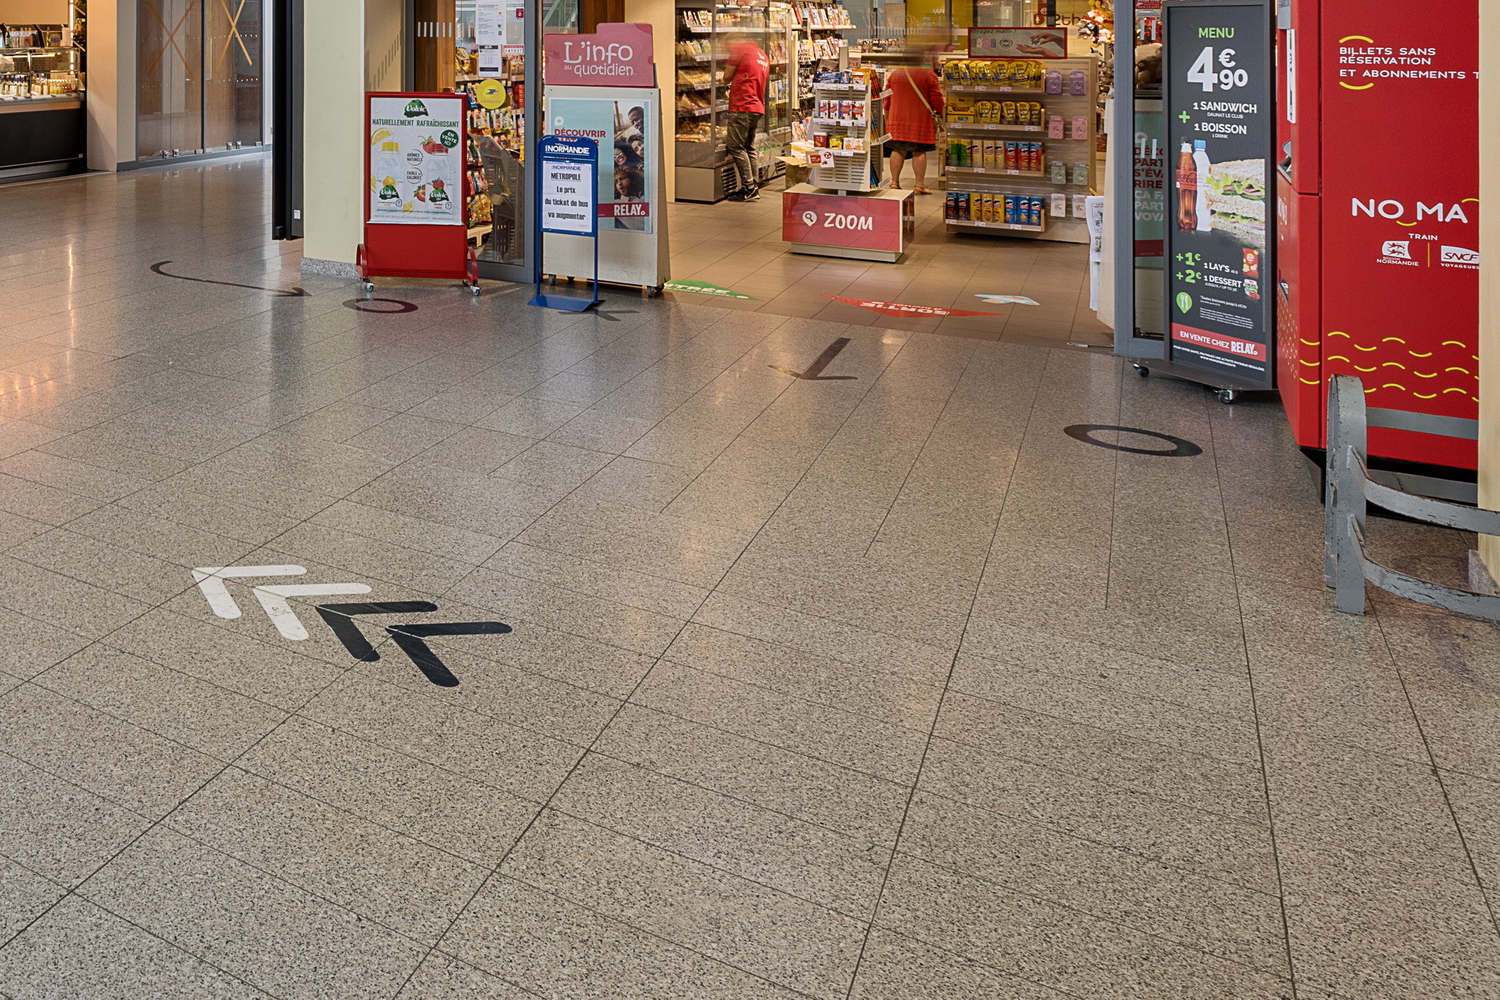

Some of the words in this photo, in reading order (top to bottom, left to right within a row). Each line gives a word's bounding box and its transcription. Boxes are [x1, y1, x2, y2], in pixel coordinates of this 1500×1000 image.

[1198, 27, 1235, 38] MENU
[564, 40, 634, 64] L'info
[1340, 47, 1393, 56] BILLETS
[1399, 48, 1436, 56] SANS
[1340, 54, 1432, 65] RÉSERVATION
[574, 62, 634, 78] quotidien
[1340, 69, 1357, 77] ET
[1362, 69, 1466, 80] ABONNEMENTS
[1193, 102, 1199, 110] 1
[1200, 101, 1257, 114] SANDWICH
[372, 118, 414, 127] NATURELLEMENT
[416, 119, 460, 128] RAFRAÎCHISSANT
[1194, 123, 1200, 131] 1
[1202, 122, 1247, 135] BOISSON
[554, 128, 606, 138] DÉCOUVRIR
[442, 134, 458, 144] VENTE
[550, 172, 582, 180] MÉTROPOLE
[564, 186, 576, 194] prix
[1135, 180, 1163, 189] RIRE
[614, 204, 642, 216] RELAY
[556, 212, 586, 220] augmenter
[823, 212, 873, 231] ZOOM
[1408, 233, 1438, 241] TRAIN
[1443, 252, 1479, 261] SNCF
[1209, 262, 1230, 273] LAY'S
[1376, 258, 1419, 267] NORMANDIE
[1210, 275, 1242, 288] DESSERT
[860, 302, 950, 316] SORTIE
[1180, 330, 1189, 339] EN
[1190, 333, 1210, 344] VENTE
[1212, 338, 1230, 349] CHEZ
[1231, 340, 1256, 355] RELAY
